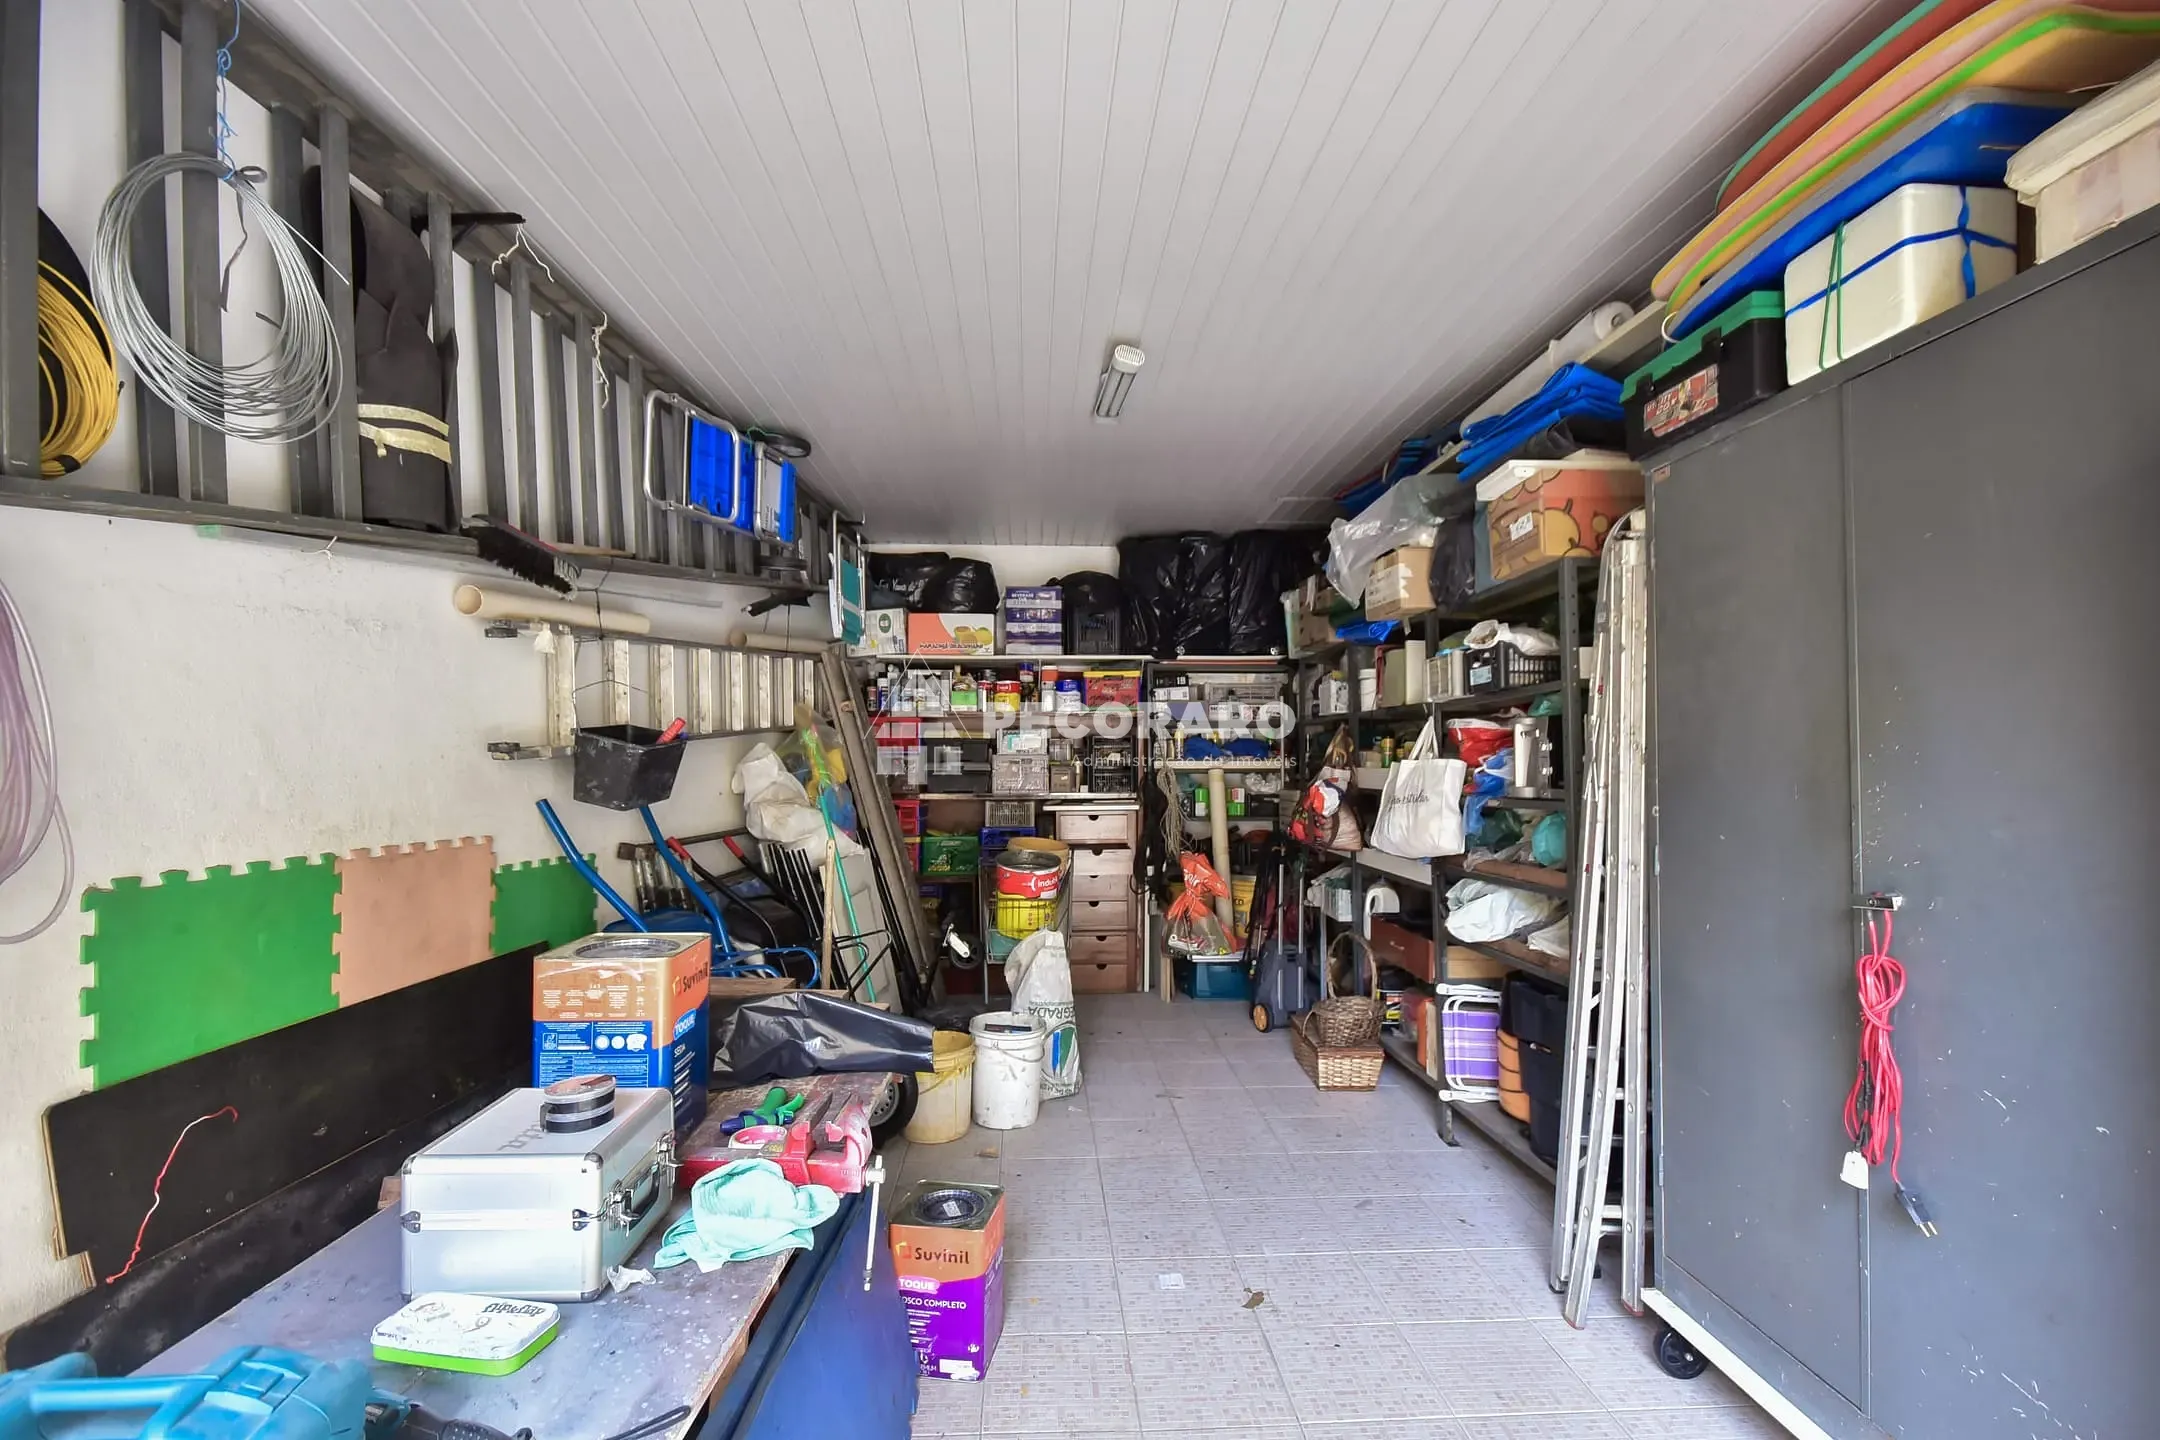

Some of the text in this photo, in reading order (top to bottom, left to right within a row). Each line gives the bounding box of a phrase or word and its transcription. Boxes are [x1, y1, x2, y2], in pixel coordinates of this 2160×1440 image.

[683, 962, 708, 993] Suvinil
[1027, 1006, 1076, 1019] EGRADA
[675, 1013, 696, 1036] TOQUE
[914, 1247, 970, 1264] Suvinil
[899, 1278, 936, 1291] TOQUE
[901, 1296, 967, 1310] OSCO COMPLETO
